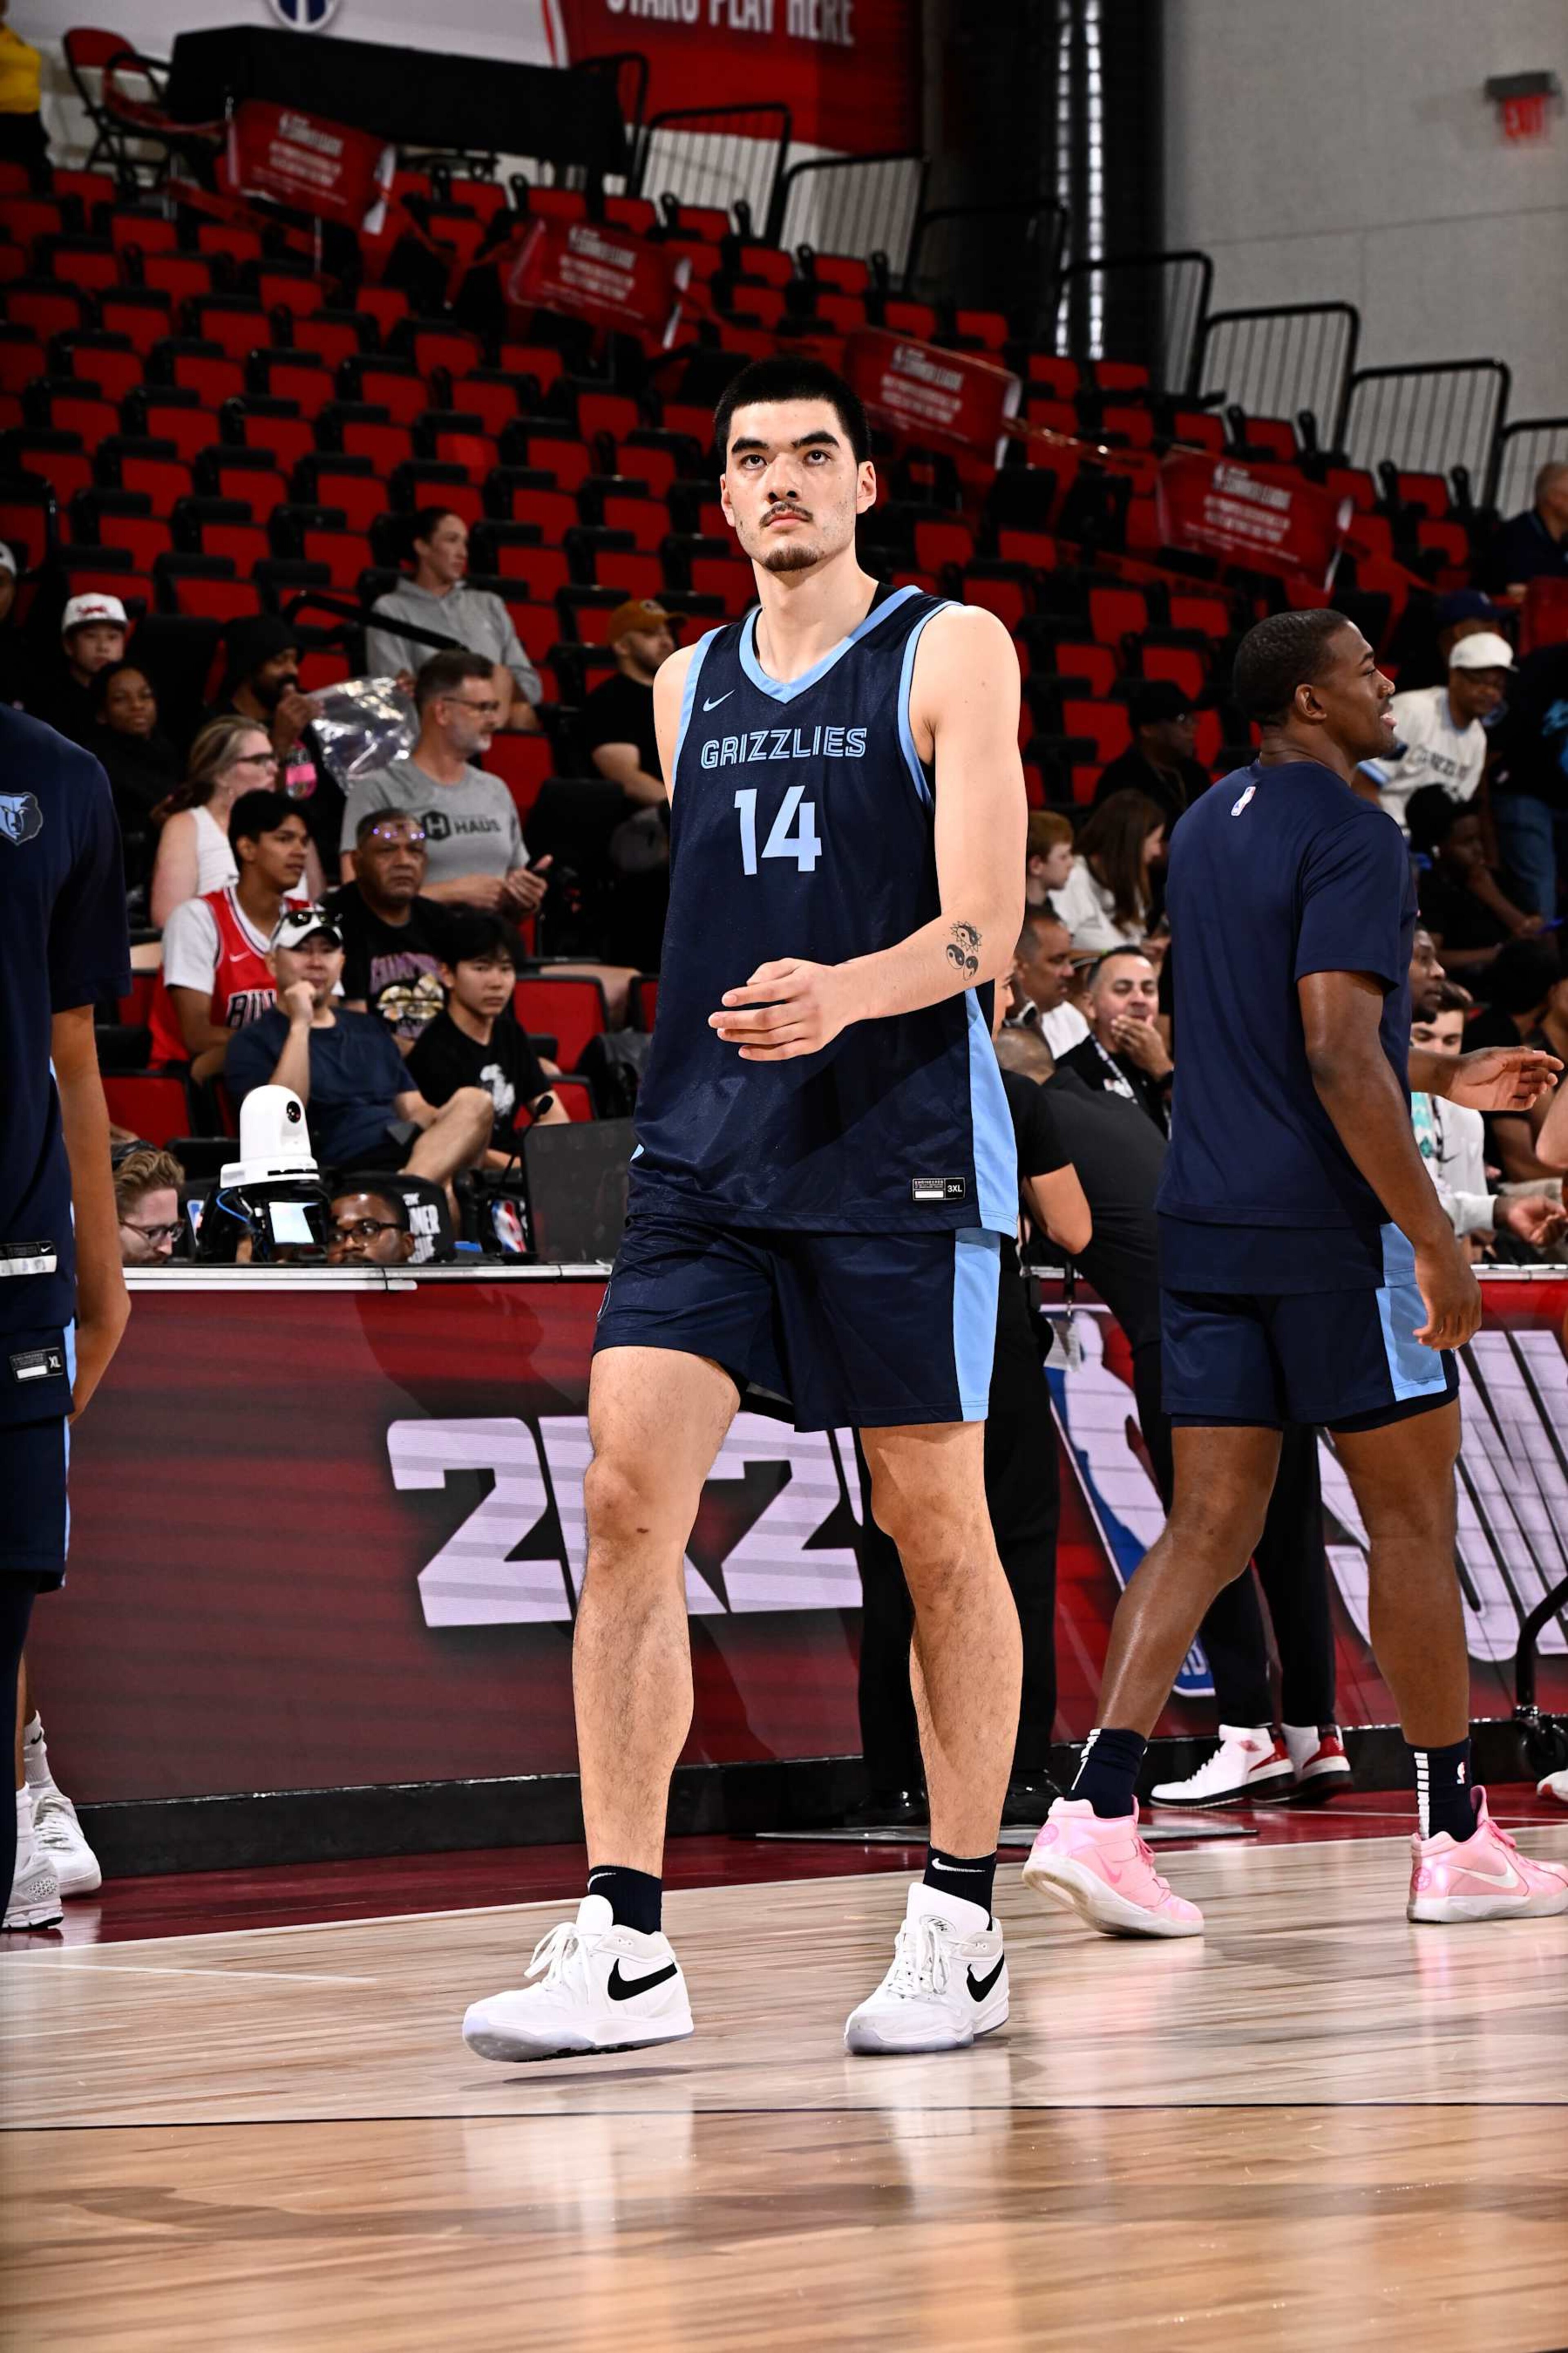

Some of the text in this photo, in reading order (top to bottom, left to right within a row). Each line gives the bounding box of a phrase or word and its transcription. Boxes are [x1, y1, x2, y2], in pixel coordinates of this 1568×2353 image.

[700, 726, 868, 770] GRIZZLIES
[453, 817, 501, 834] HAUS
[733, 785, 822, 876] 14
[947, 1184, 962, 1193] 3XL
[48, 1355, 61, 1369] XL
[386, 1411, 863, 1627] 22
